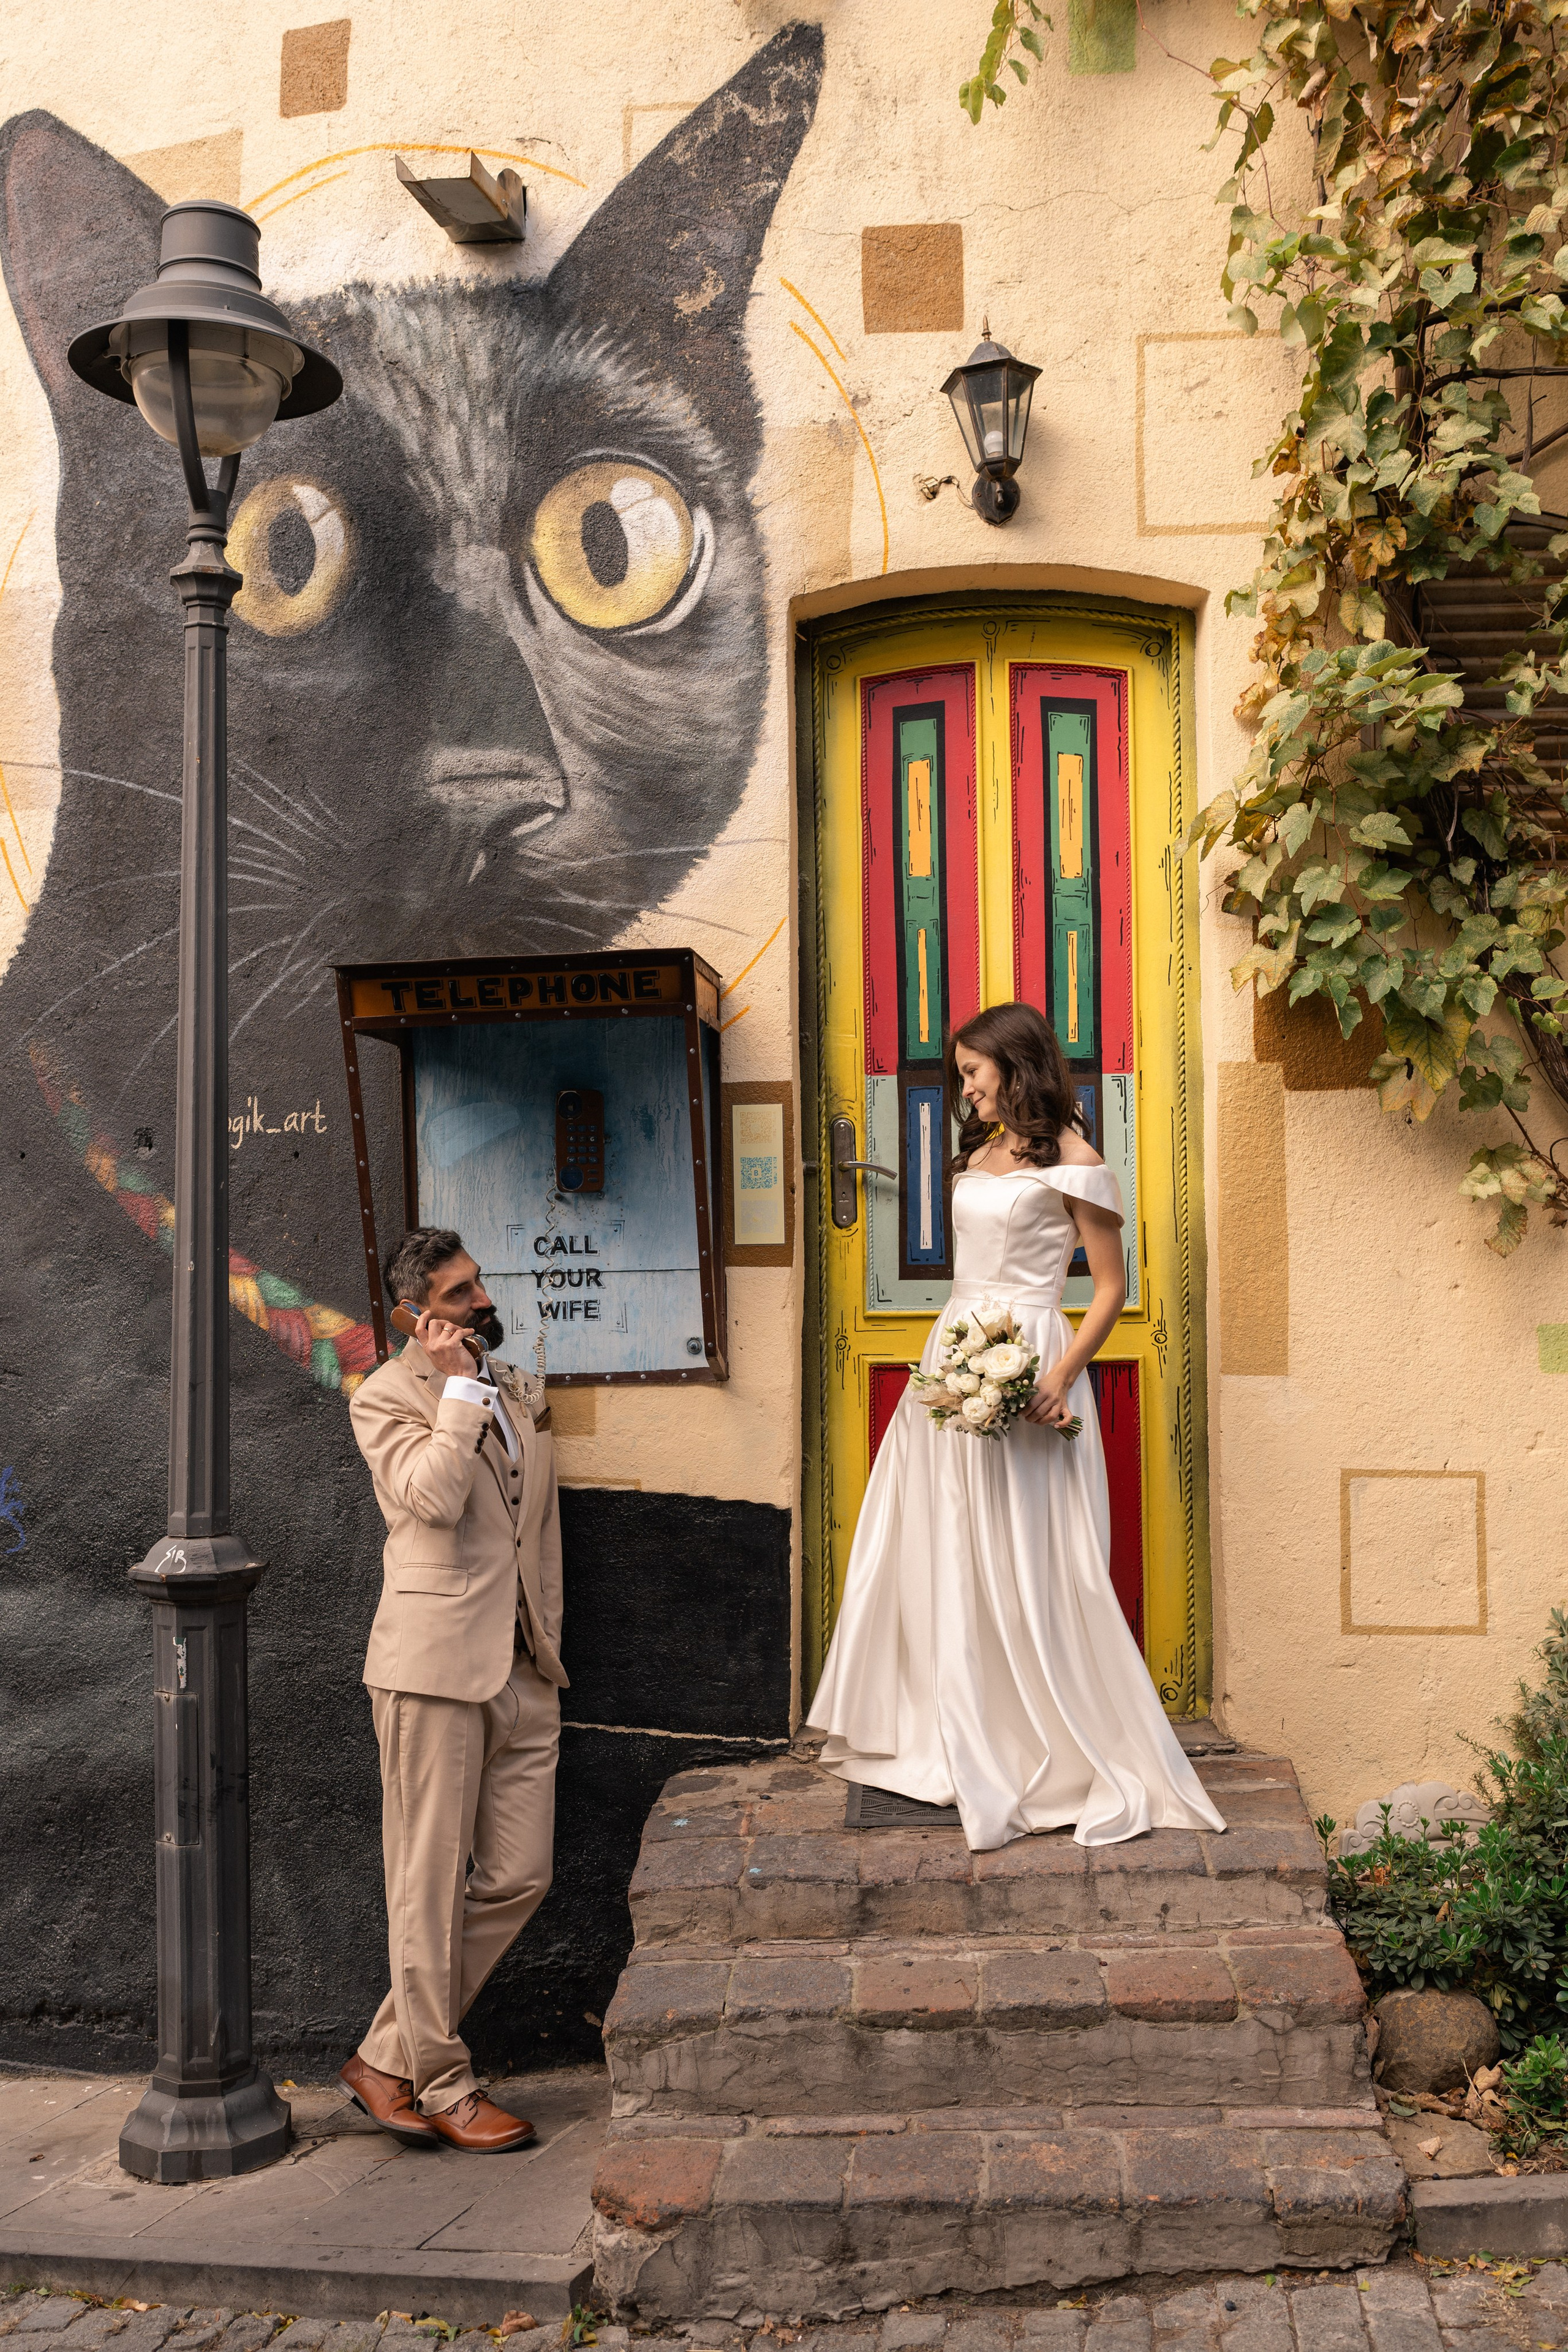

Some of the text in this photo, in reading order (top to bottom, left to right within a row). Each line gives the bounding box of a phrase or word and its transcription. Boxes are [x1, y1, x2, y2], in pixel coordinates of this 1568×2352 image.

[381, 970, 661, 1012] TELEPHONE
[228, 1096, 327, 1149] gik_art
[533, 1235, 599, 1257] CALL
[531, 1268, 605, 1290] YOUR
[537, 1299, 601, 1321] WIFE
